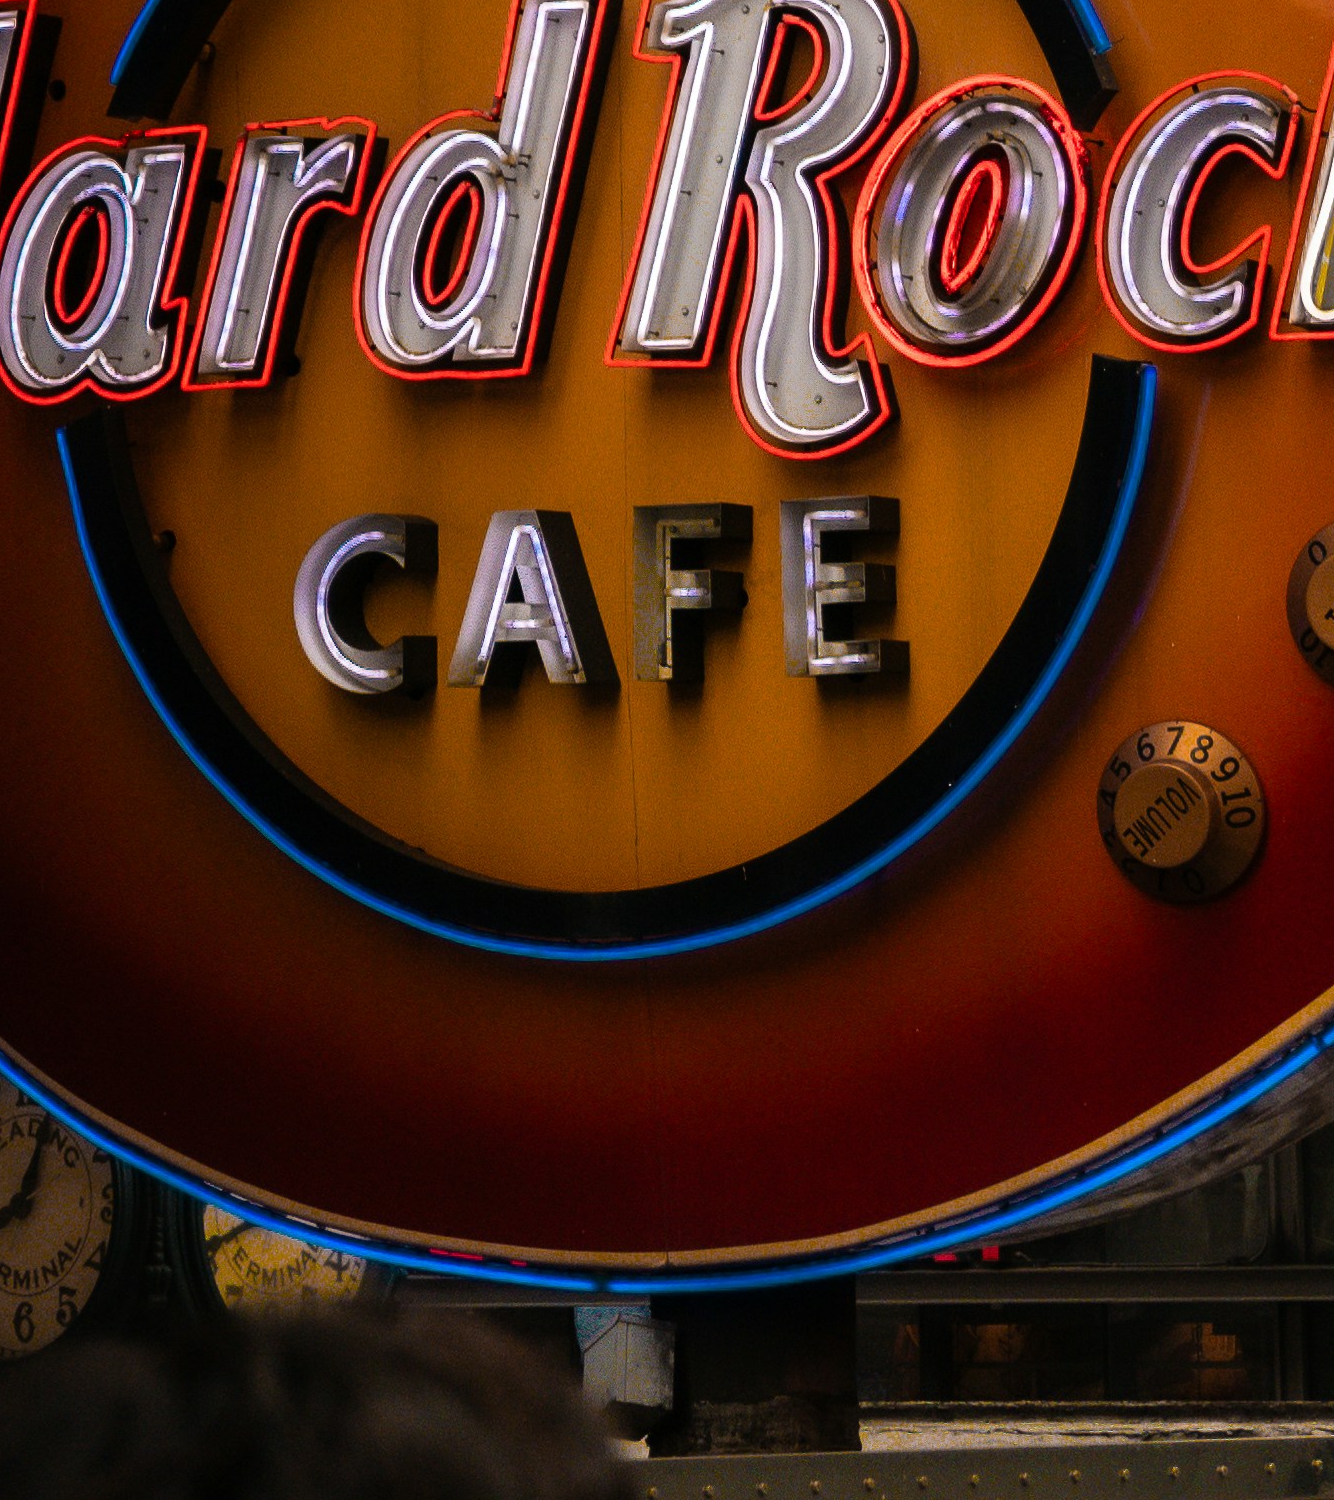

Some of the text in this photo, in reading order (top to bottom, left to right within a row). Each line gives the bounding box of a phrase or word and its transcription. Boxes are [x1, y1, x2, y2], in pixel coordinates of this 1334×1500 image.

[293, 496, 910, 695] CAFE
[1136, 733, 1155, 762] 6
[1167, 726, 1185, 756] 7
[1190, 735, 1214, 764] 8
[1110, 756, 1131, 782] 5
[1211, 756, 1240, 782] 9
[1122, 777, 1201, 858] VOLUME
[1221, 787, 1256, 829] 10
[13, 1301, 36, 1344] 6
